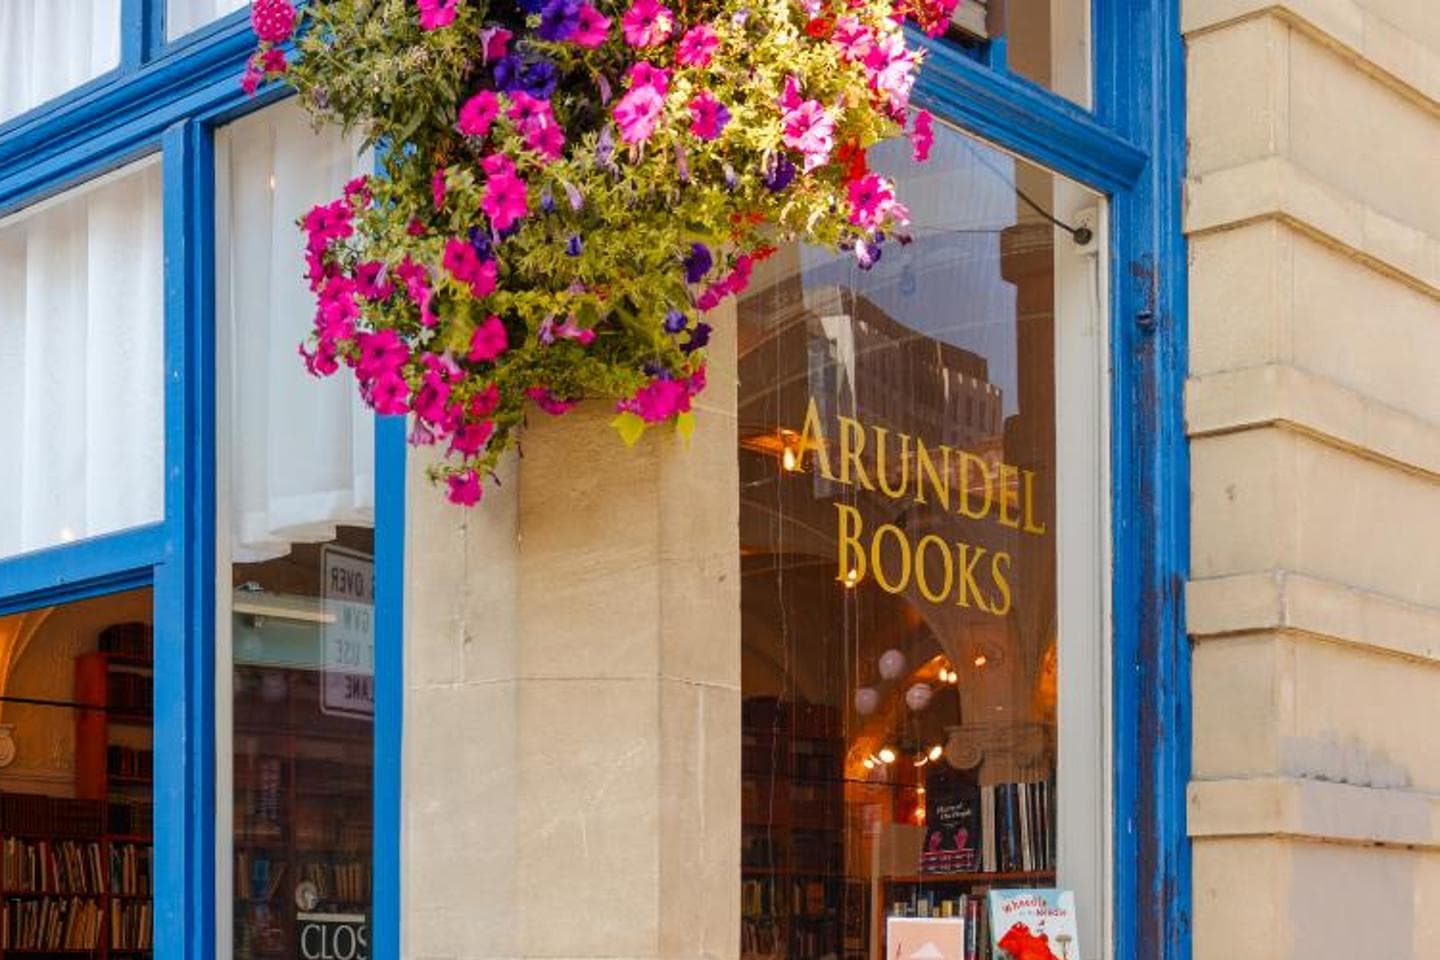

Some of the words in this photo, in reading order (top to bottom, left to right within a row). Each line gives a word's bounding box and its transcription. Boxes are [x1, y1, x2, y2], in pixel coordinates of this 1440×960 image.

[794, 396, 1046, 535] ARUNDEL
[833, 502, 1011, 616] BOOKS
[301, 924, 368, 960] CLOS
